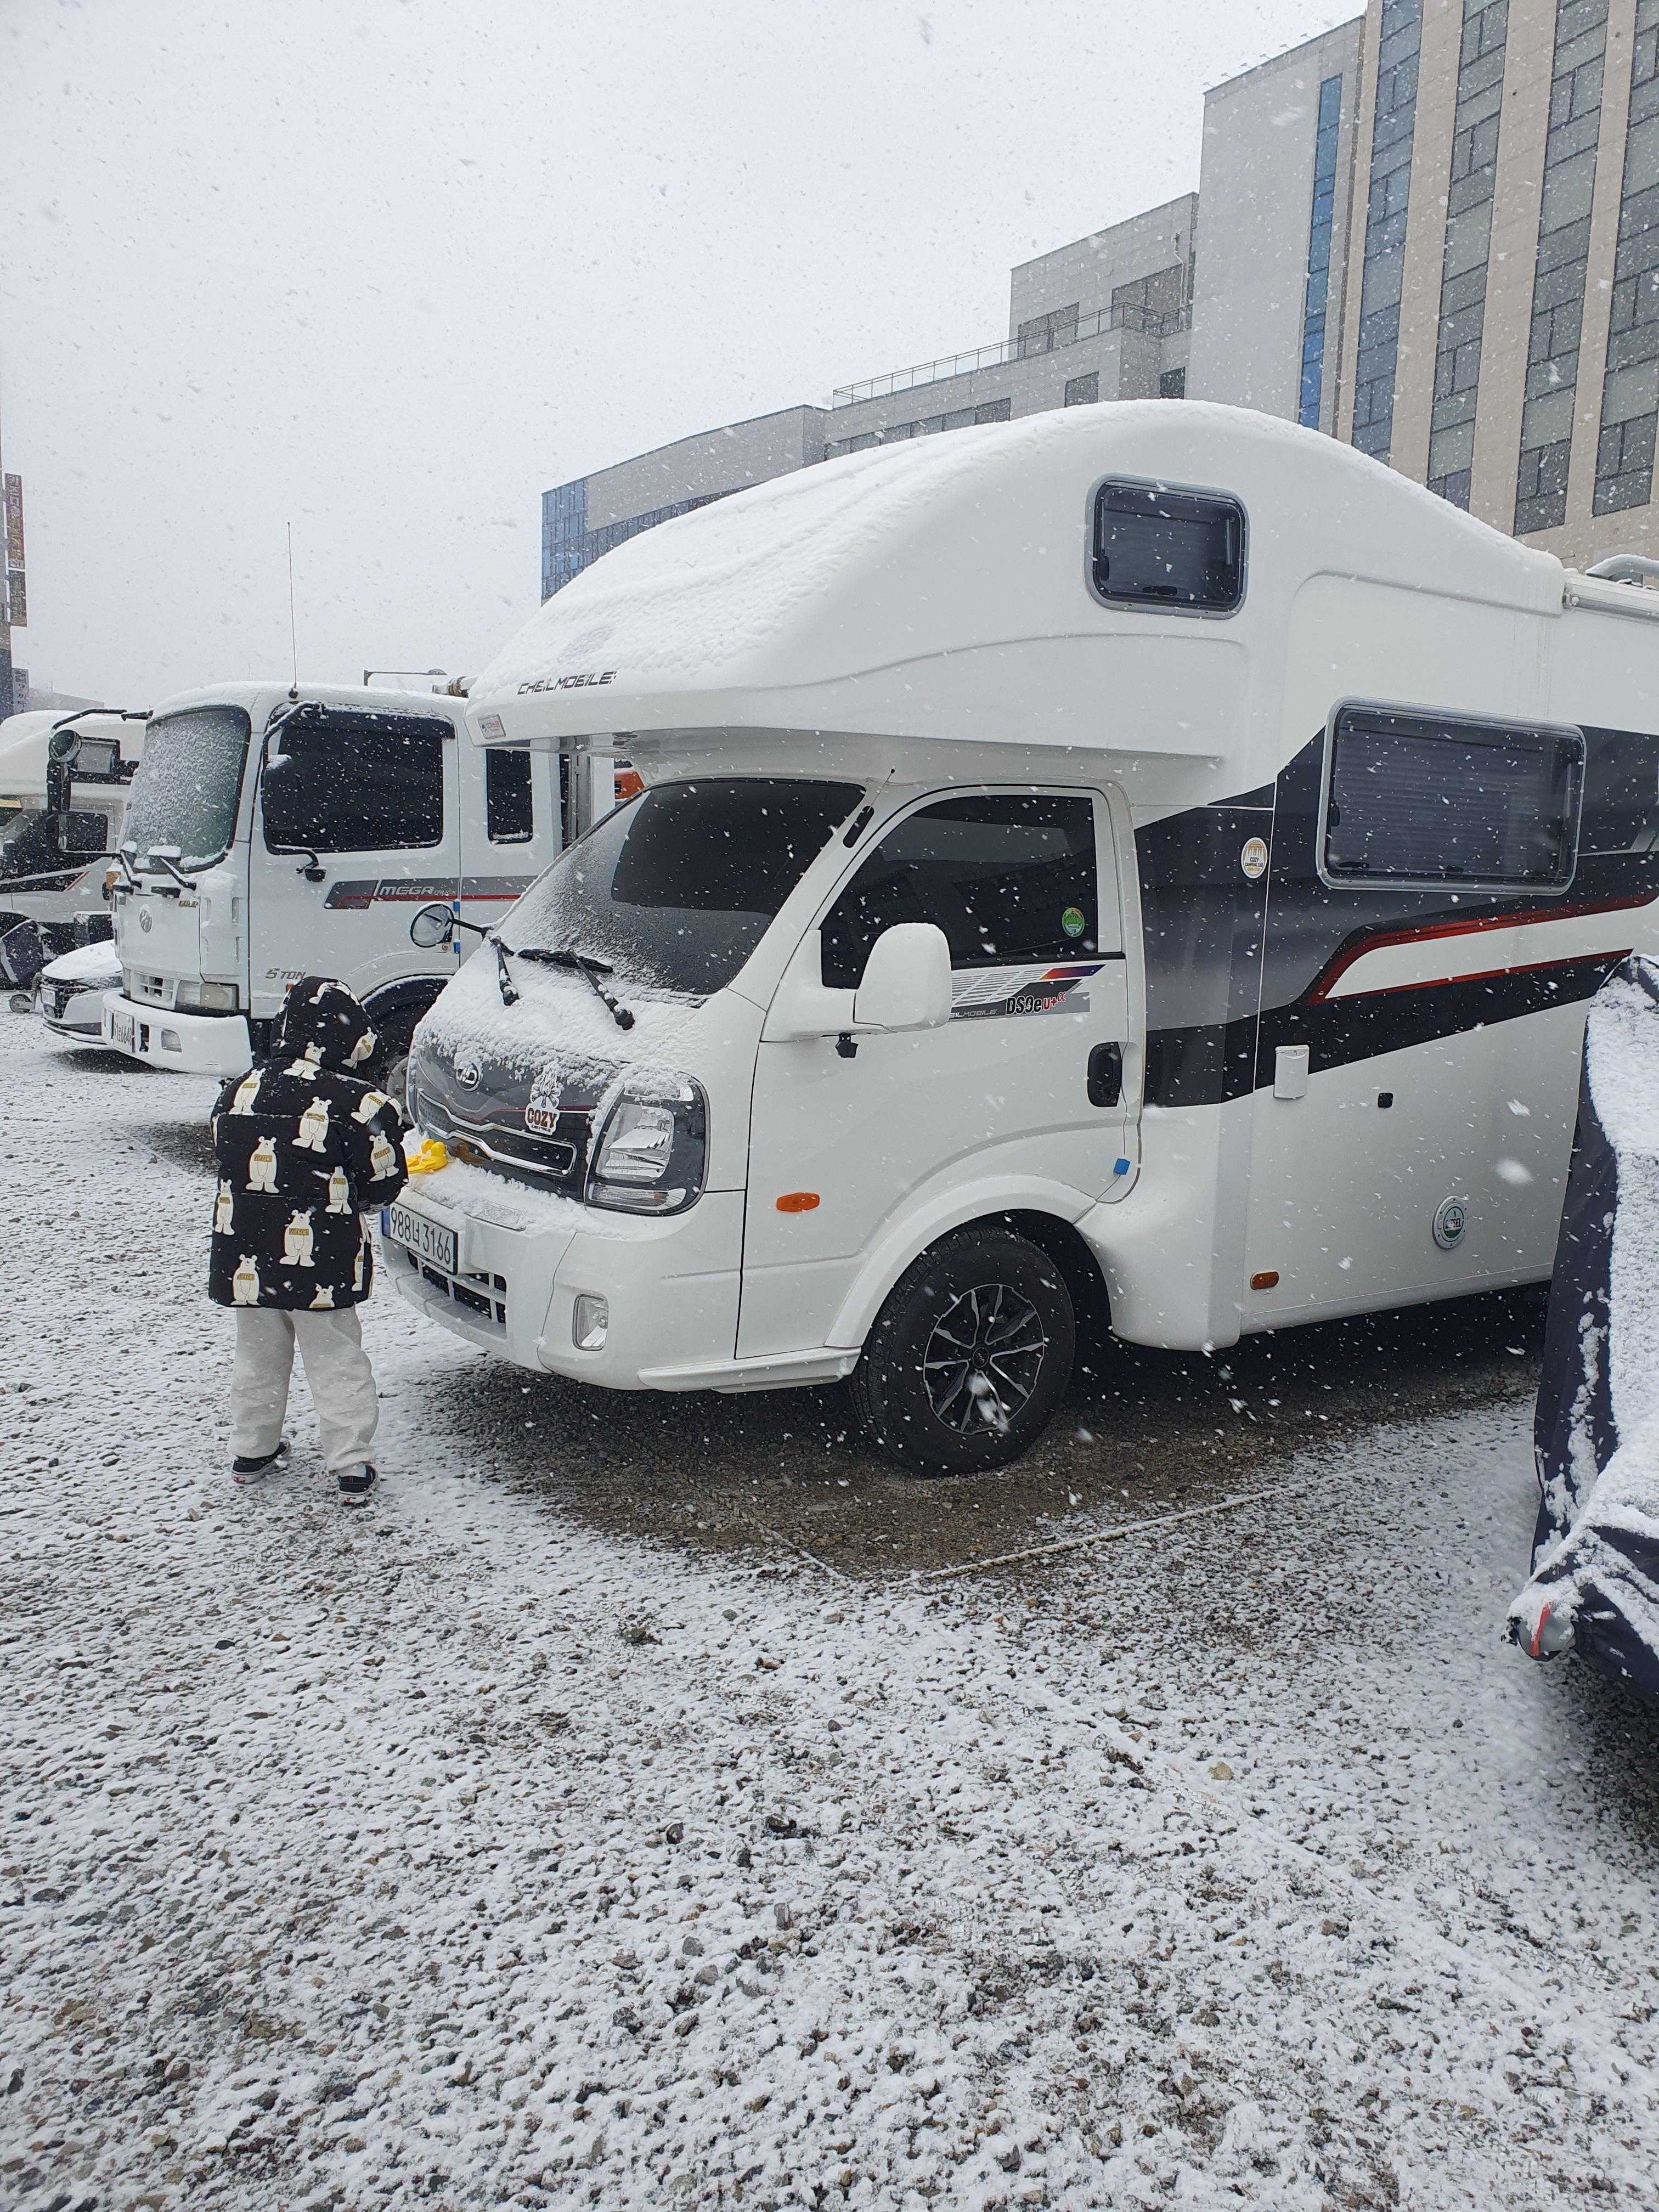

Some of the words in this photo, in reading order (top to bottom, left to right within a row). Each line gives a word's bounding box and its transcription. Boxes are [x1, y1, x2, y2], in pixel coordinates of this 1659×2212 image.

[265, 968, 280, 979] 5
[280, 970, 307, 979] TON
[527, 1107, 557, 1128] COZY
[1445, 1218, 1461, 1229] DESEL
[391, 1206, 451, 1265] 988너3166
